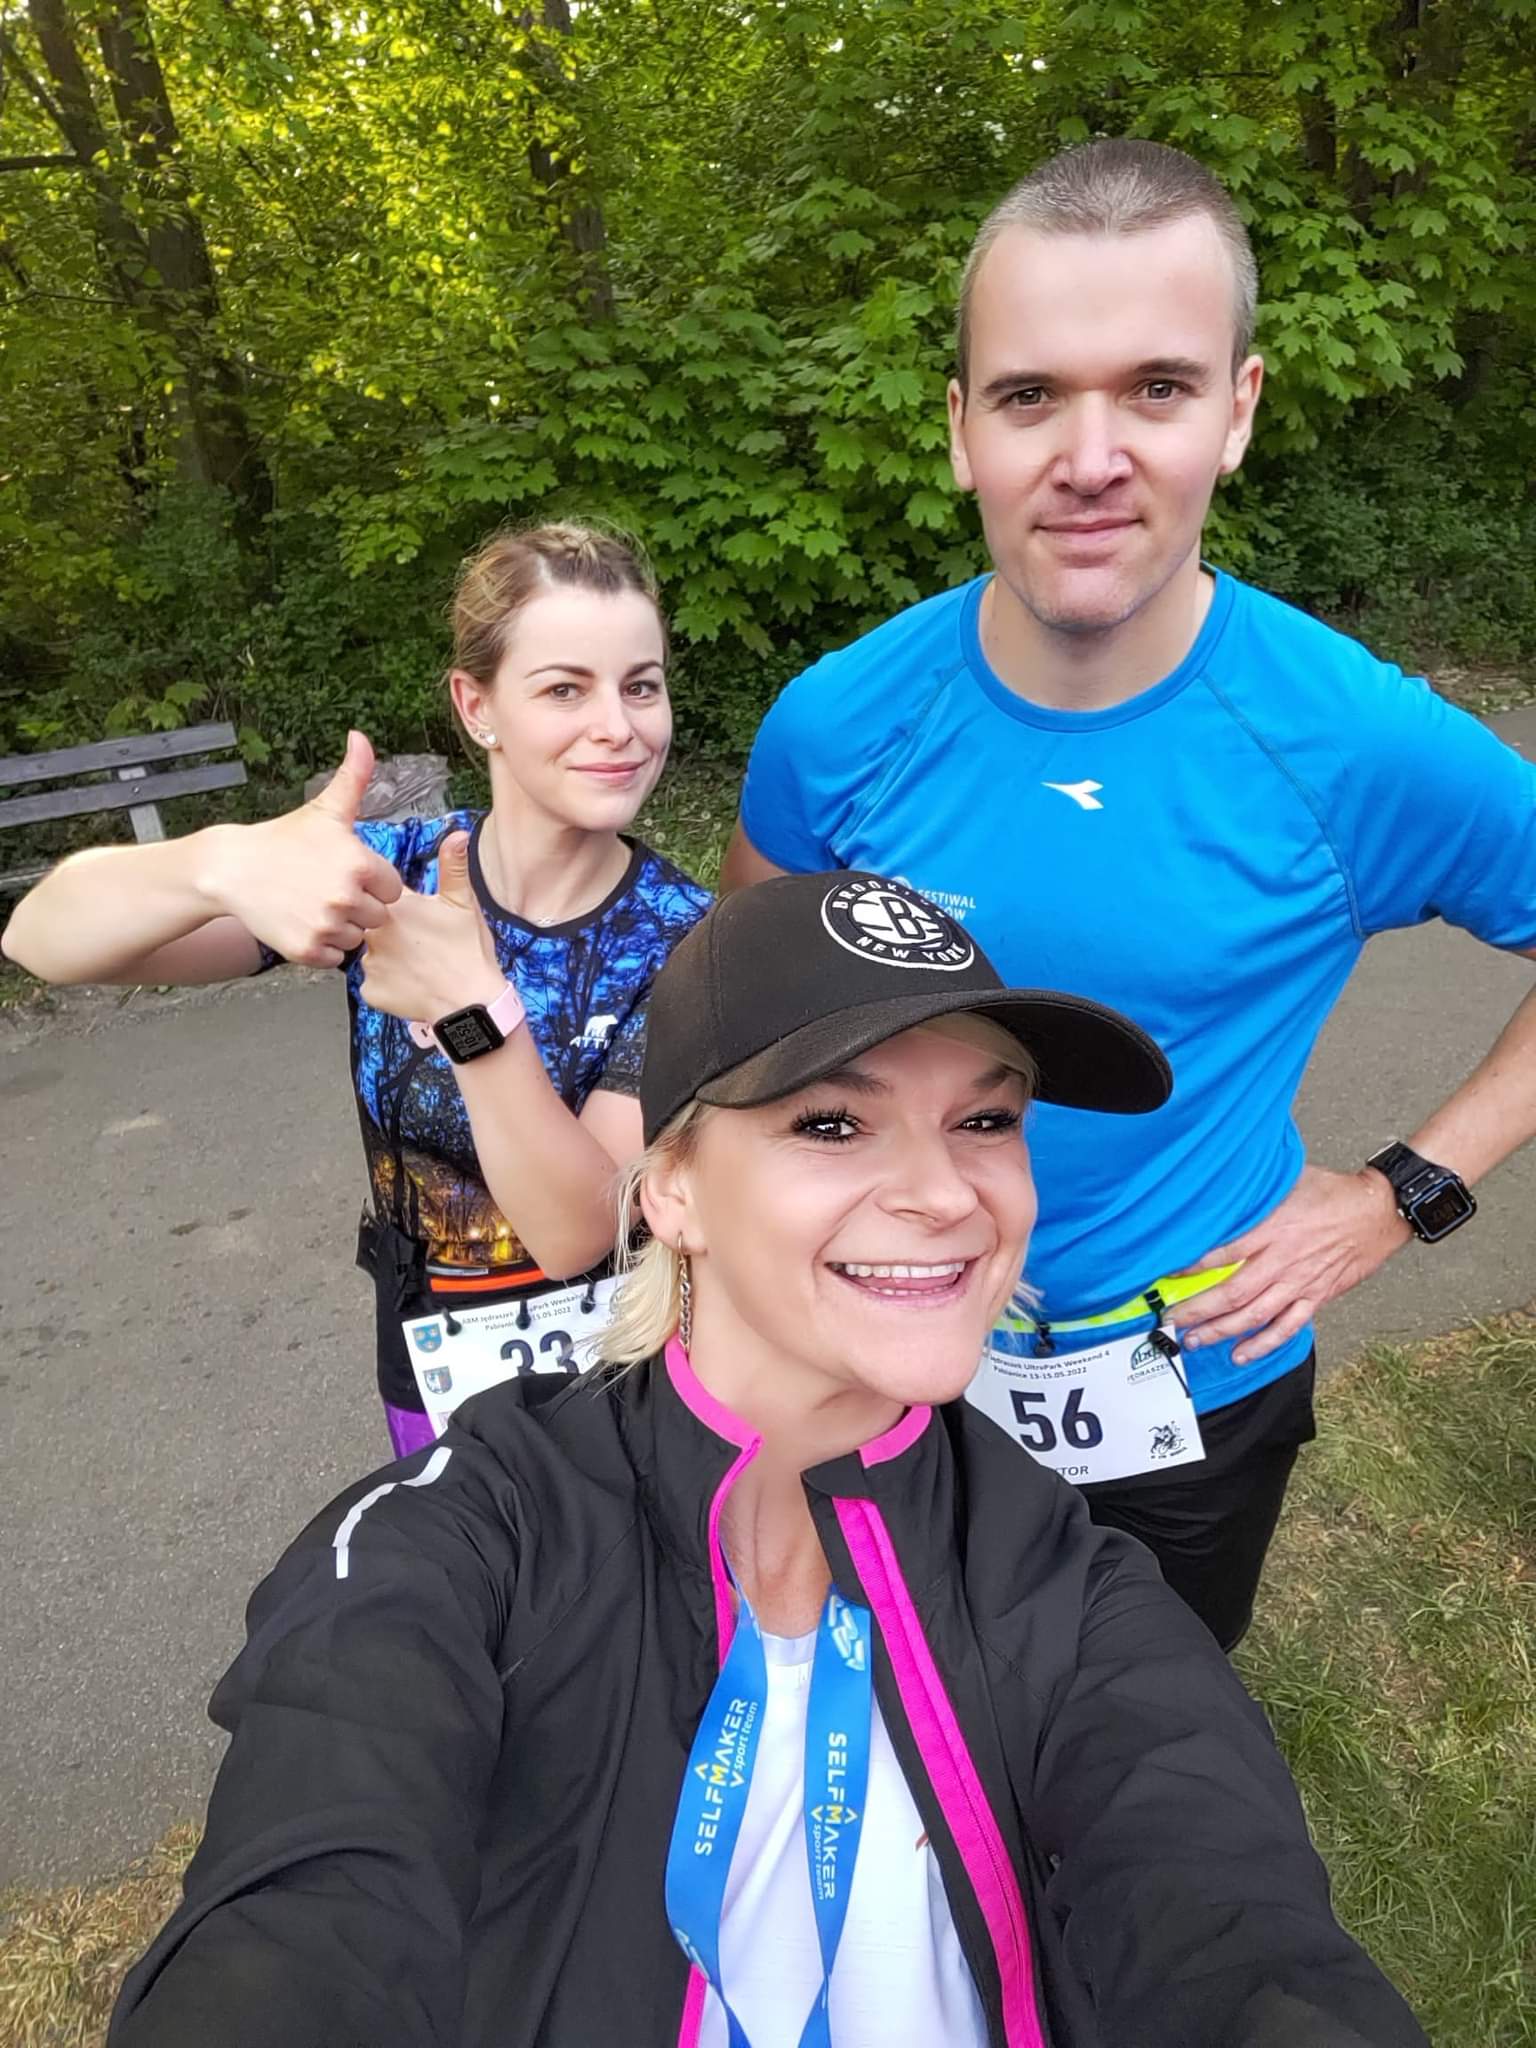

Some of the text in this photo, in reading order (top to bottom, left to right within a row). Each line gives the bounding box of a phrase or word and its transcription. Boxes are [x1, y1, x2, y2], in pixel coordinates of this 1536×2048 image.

[856, 936, 966, 961] NEW YORK
[569, 1036, 610, 1050] ATTI
[1009, 1387, 1103, 1452] 56
[733, 1701, 759, 1771] sport team
[694, 1698, 749, 1857] SELFMAKER
[812, 1823, 824, 1862] sport
[822, 1731, 848, 1900] SELFMAKER
